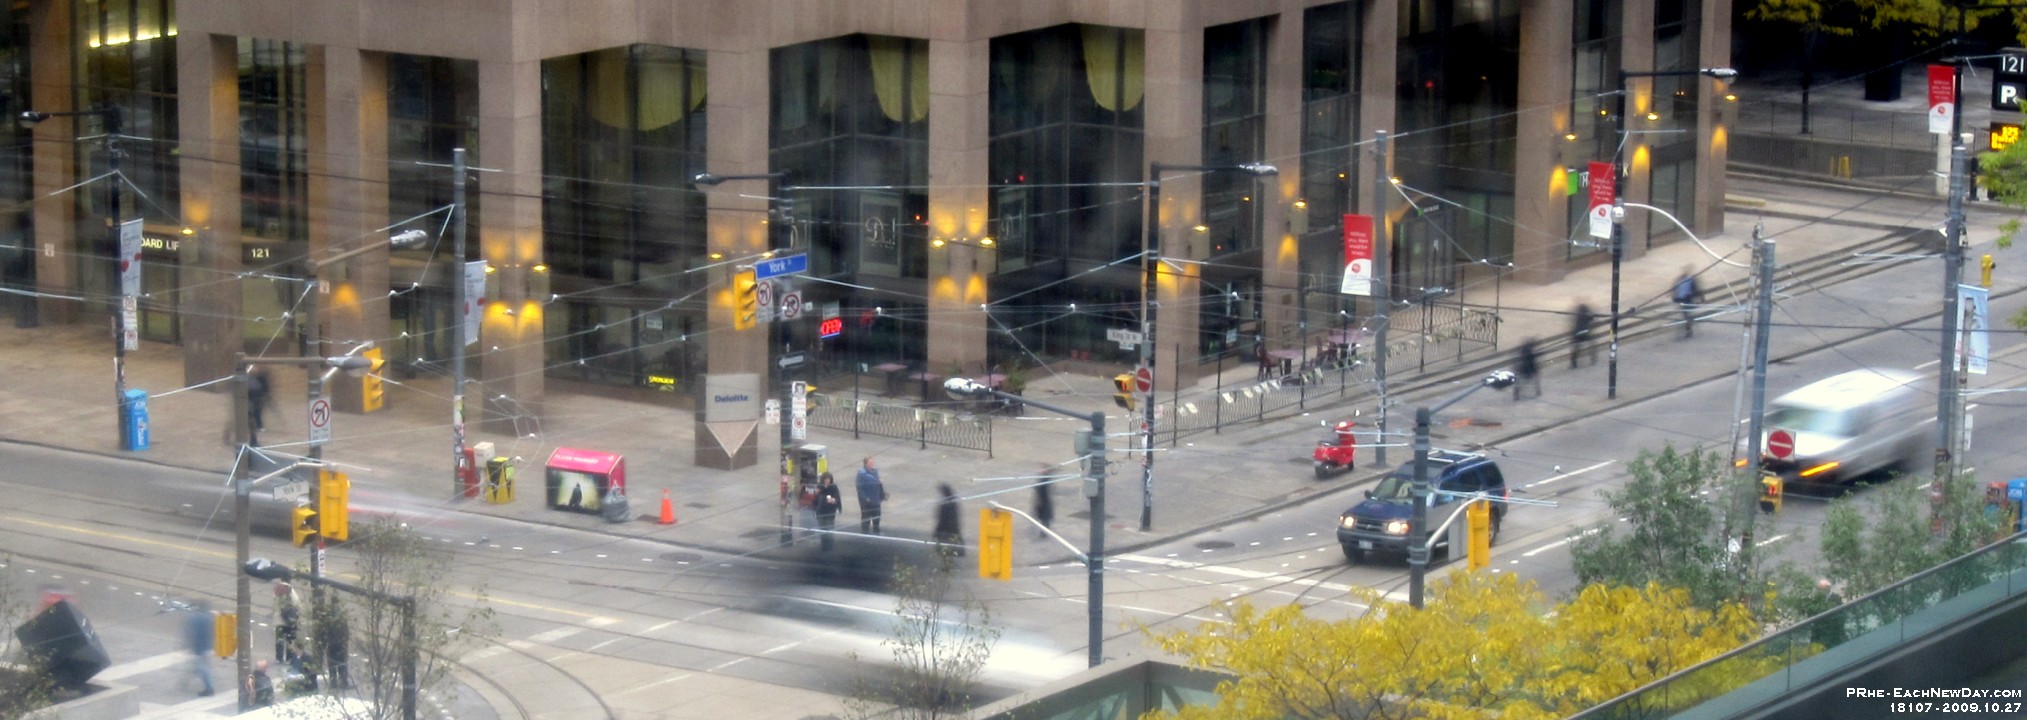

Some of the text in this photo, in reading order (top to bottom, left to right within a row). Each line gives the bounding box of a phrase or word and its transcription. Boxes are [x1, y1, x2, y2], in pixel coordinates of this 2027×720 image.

[2002, 56, 2024, 73] 121
[2001, 85, 2017, 104] P
[251, 248, 270, 258] 121
[768, 261, 786, 273] York
[821, 319, 842, 335] OPEN
[715, 394, 749, 403] Deloitte
